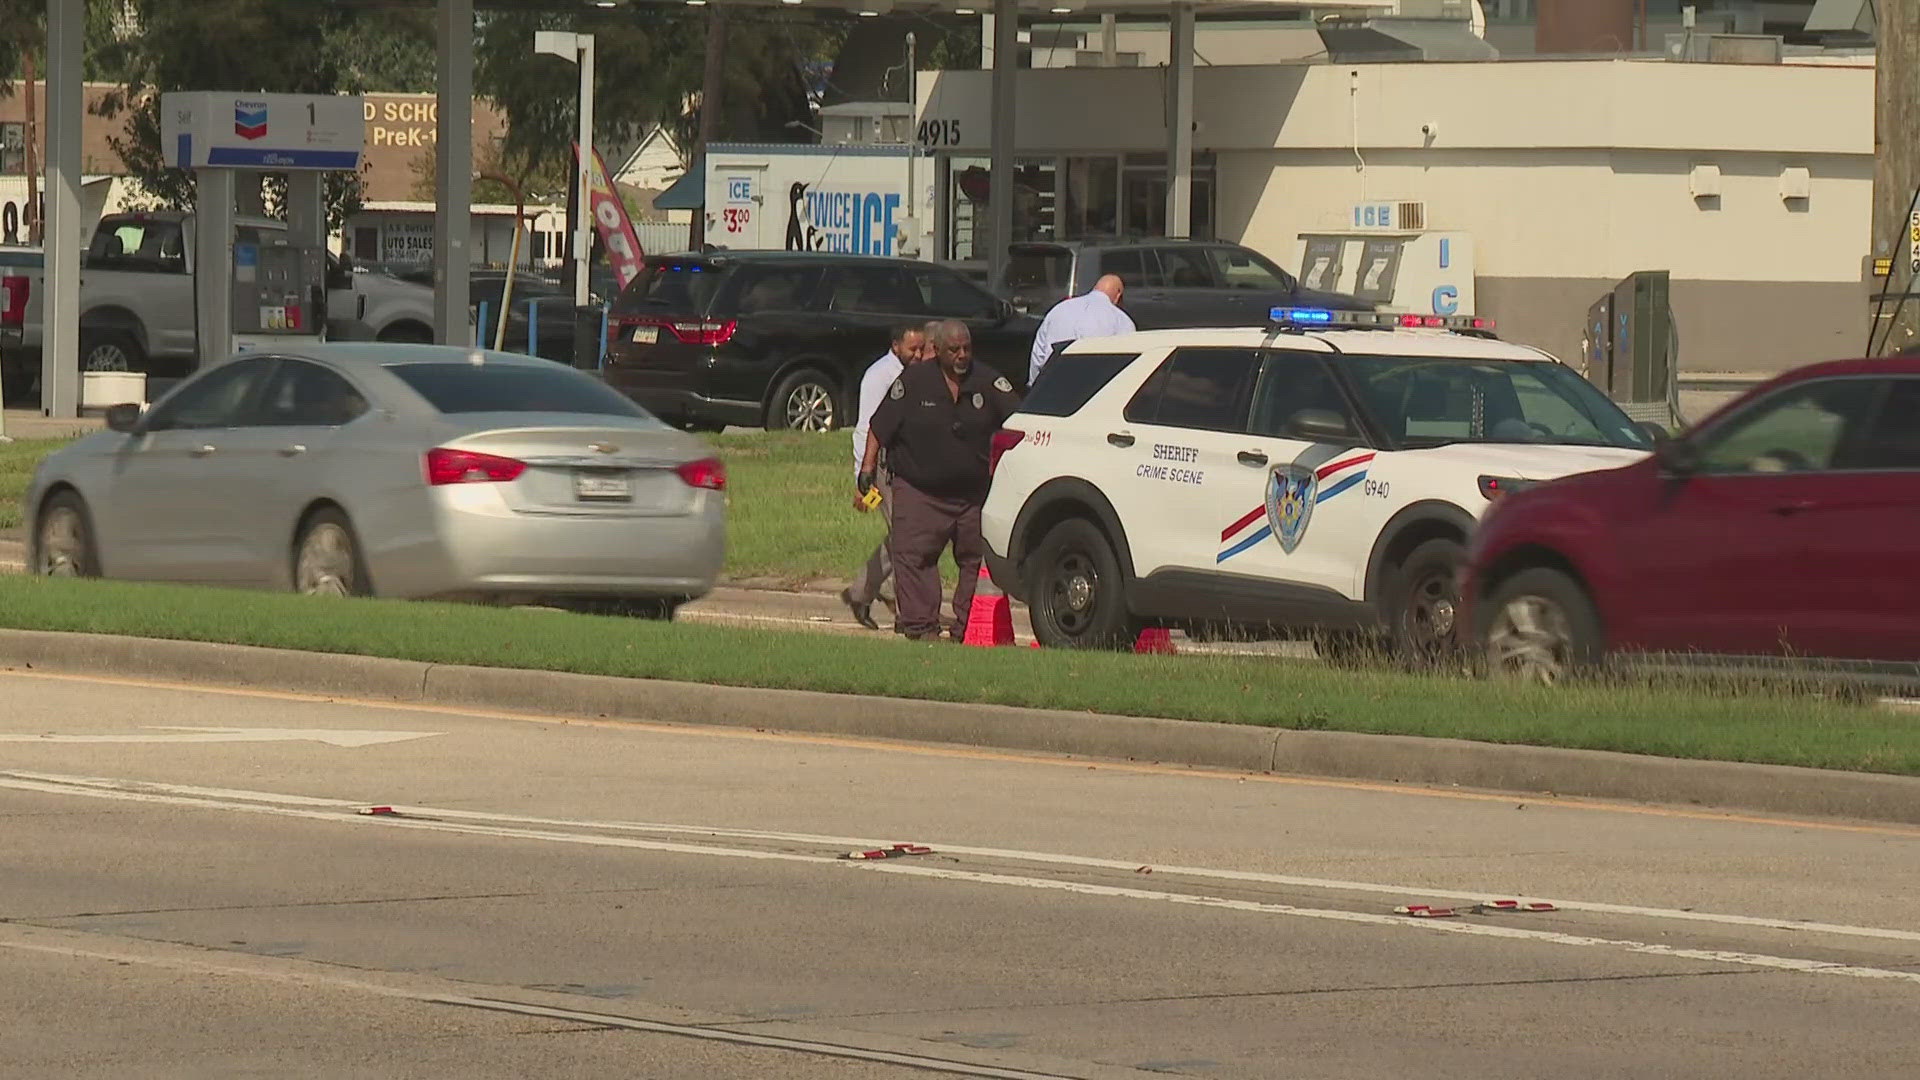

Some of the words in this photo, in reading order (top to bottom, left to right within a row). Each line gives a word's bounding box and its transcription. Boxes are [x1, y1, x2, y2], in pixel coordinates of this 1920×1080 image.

[235, 100, 267, 108] Chevron
[306, 102, 315, 125] 1
[384, 102, 437, 122] SCHO
[373, 127, 437, 146] PreK-1
[917, 119, 960, 146] 4915
[729, 182, 750, 198] ICE
[806, 191, 850, 228] TWICE
[1354, 206, 1390, 226] ICE
[852, 192, 900, 256] ICE
[407, 236, 433, 250] SALES
[826, 233, 850, 254] THE
[1034, 430, 1051, 447] 911
[1153, 443, 1199, 463] SHERIFF
[1136, 464, 1168, 480] CRIME
[1169, 468, 1204, 485] SCENE
[1365, 479, 1390, 498] G940
